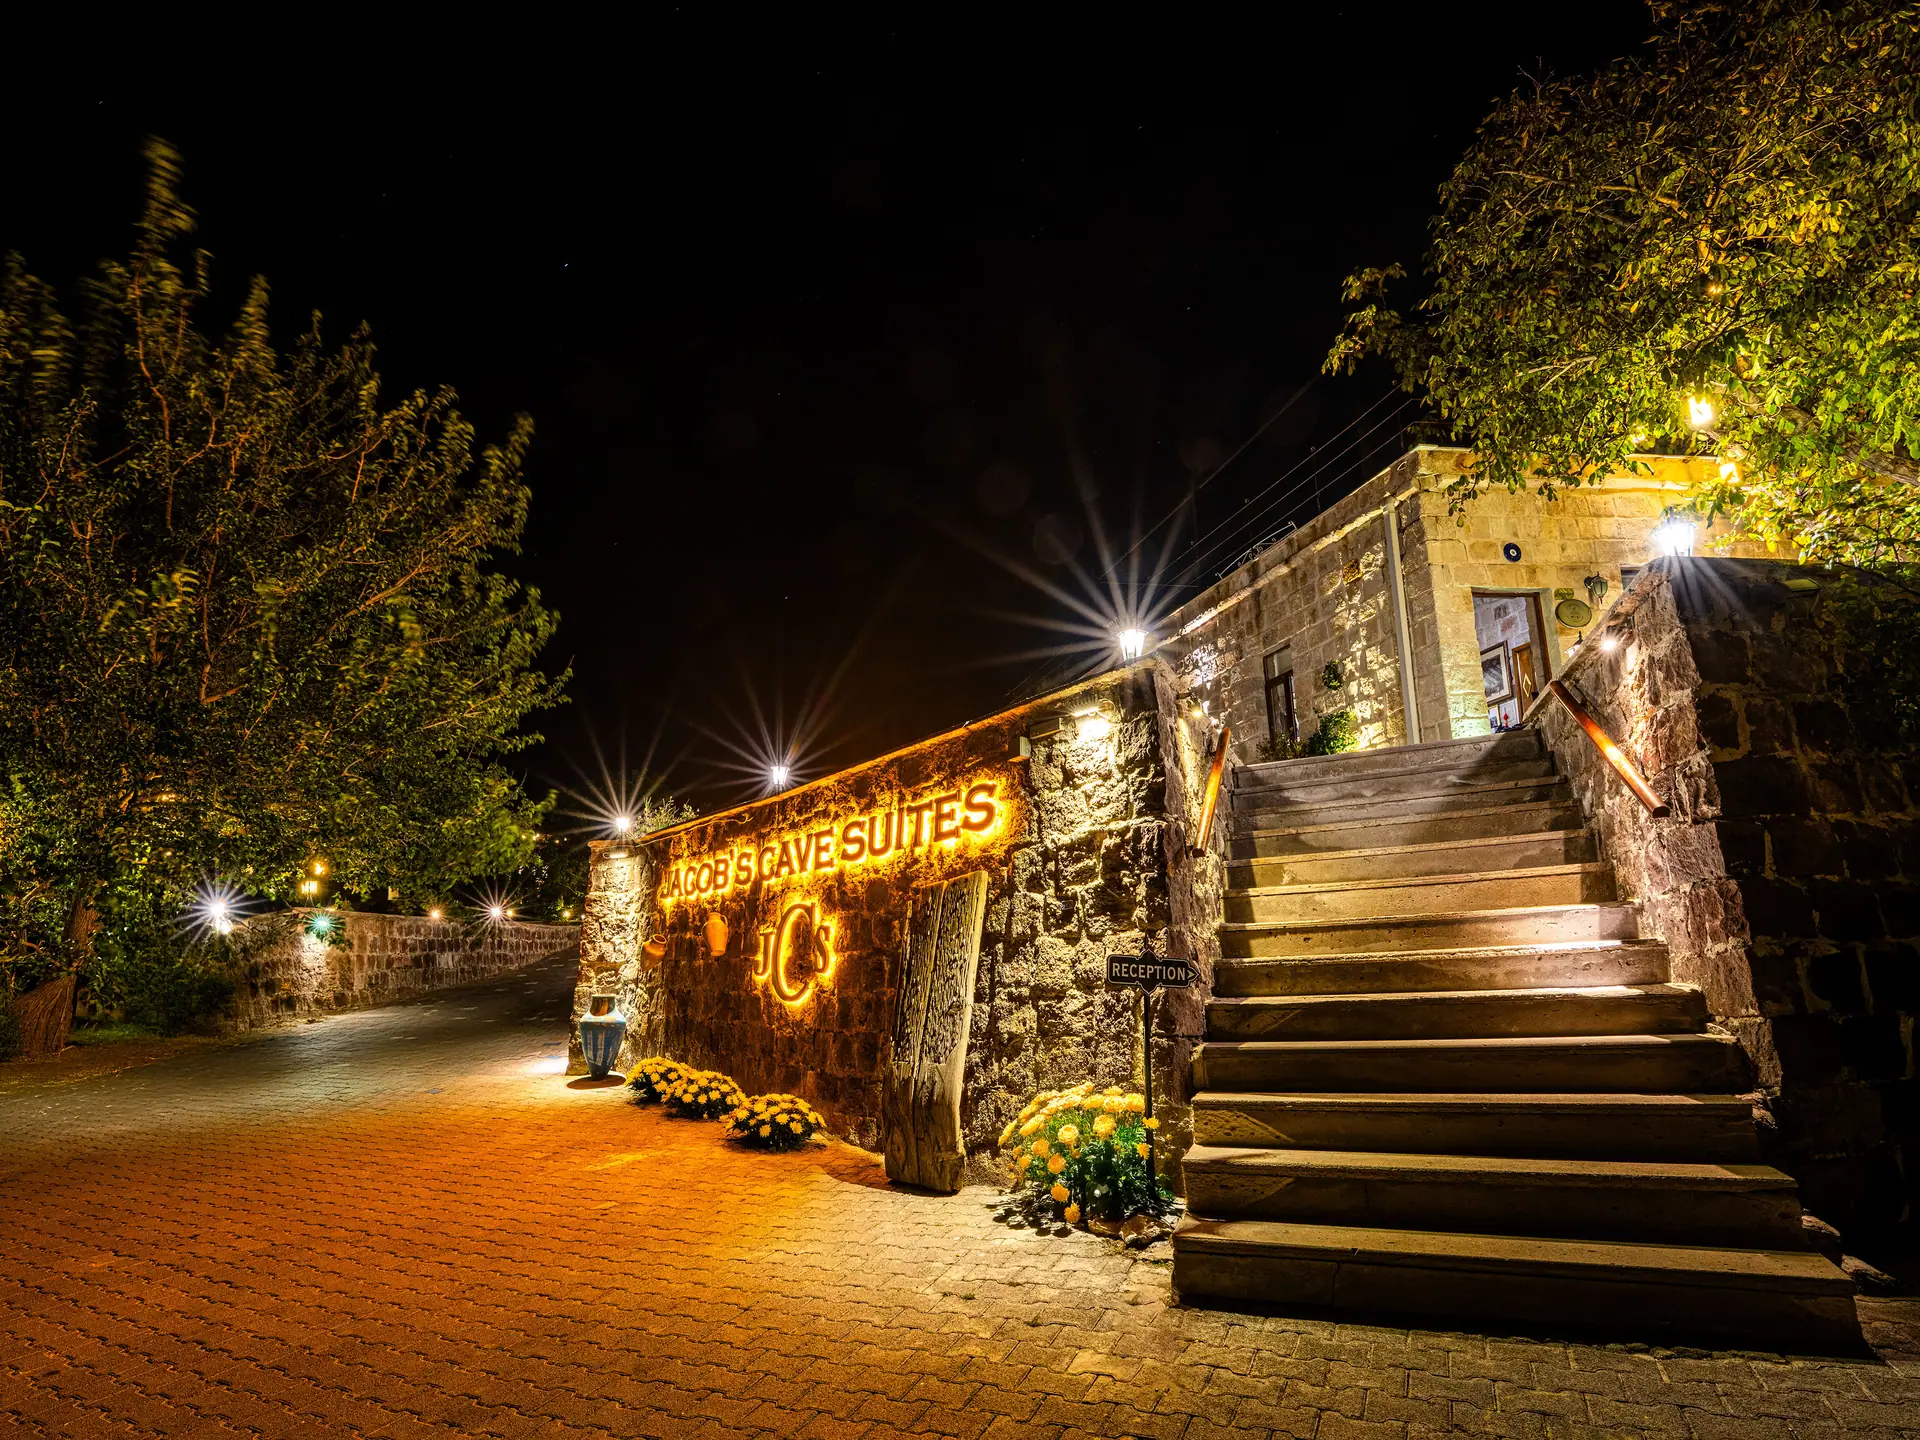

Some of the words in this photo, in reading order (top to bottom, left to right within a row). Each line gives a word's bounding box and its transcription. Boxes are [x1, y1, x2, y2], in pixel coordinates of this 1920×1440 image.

[662, 850, 754, 898] JACOB'S
[758, 828, 835, 882] CAVE
[841, 783, 997, 862] SUITES
[1112, 962, 1186, 981] RECEPTION
